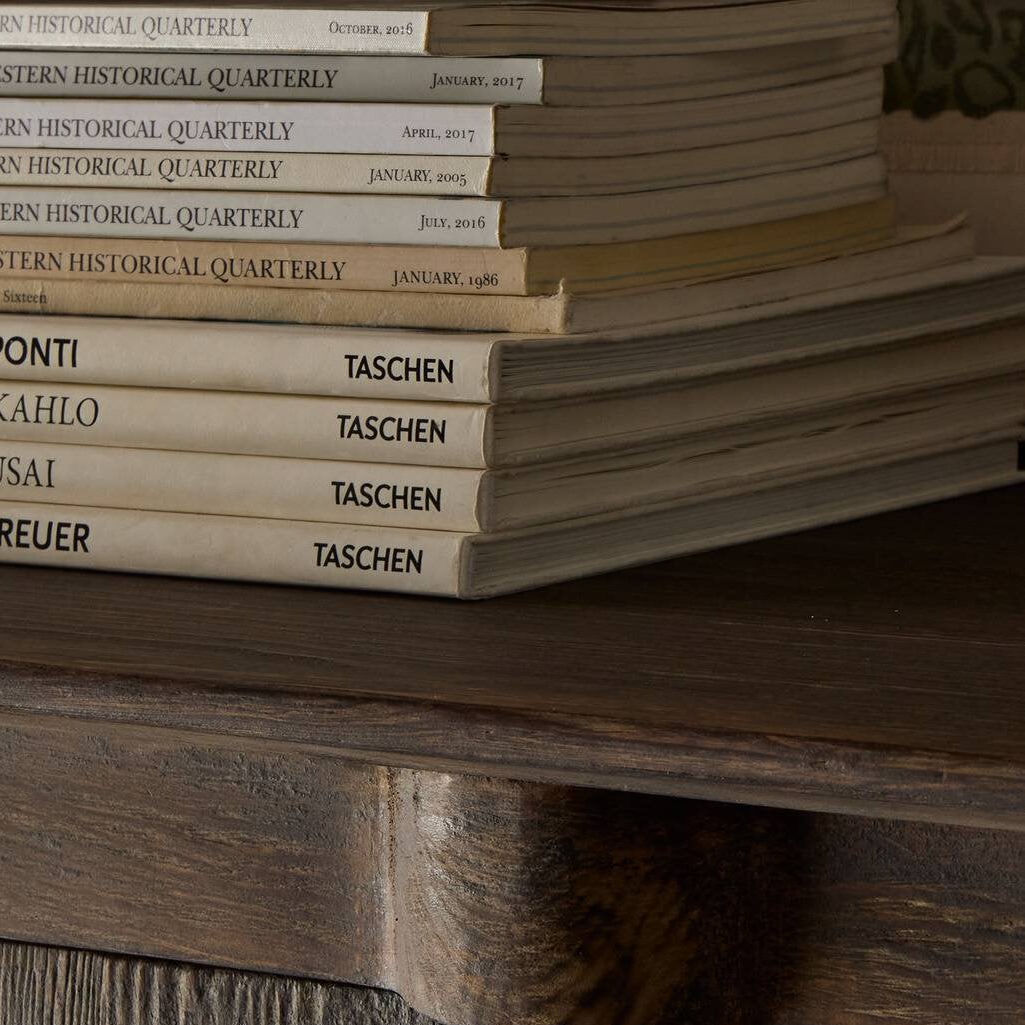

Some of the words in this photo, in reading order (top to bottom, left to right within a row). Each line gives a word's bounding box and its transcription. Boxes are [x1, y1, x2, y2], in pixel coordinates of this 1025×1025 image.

[28, 15, 136, 35] HISTORICAL
[141, 16, 253, 41] QUARTERLY
[74, 66, 202, 87] HISTORICAL
[208, 68, 339, 92] QUARTERLY
[493, 77, 524, 90] 2017
[38, 118, 162, 138] HISTORICAL
[168, 120, 294, 144] QUARTERLY
[445, 128, 475, 142] 2017
[28, 156, 152, 176] HISTORICAL
[158, 159, 283, 182] QUARTERLY
[368, 168, 433, 184] JANUARY,
[437, 173, 467, 187] 2005
[46, 205, 171, 226] HISTORICAL
[177, 207, 303, 231] QUARTERLY
[455, 217, 485, 229] 2016
[69, 253, 206, 277] HISTORICAL
[211, 257, 346, 282] QUARTERLY
[392, 270, 464, 287] JANUARY,
[469, 274, 498, 289] 1986
[4, 290, 47, 304] Sixteen
[344, 355, 453, 383] TASCHEN
[337, 415, 446, 444] TASCHEN
[331, 481, 441, 512] TASCHEN
[313, 542, 423, 574] TASCHEN
